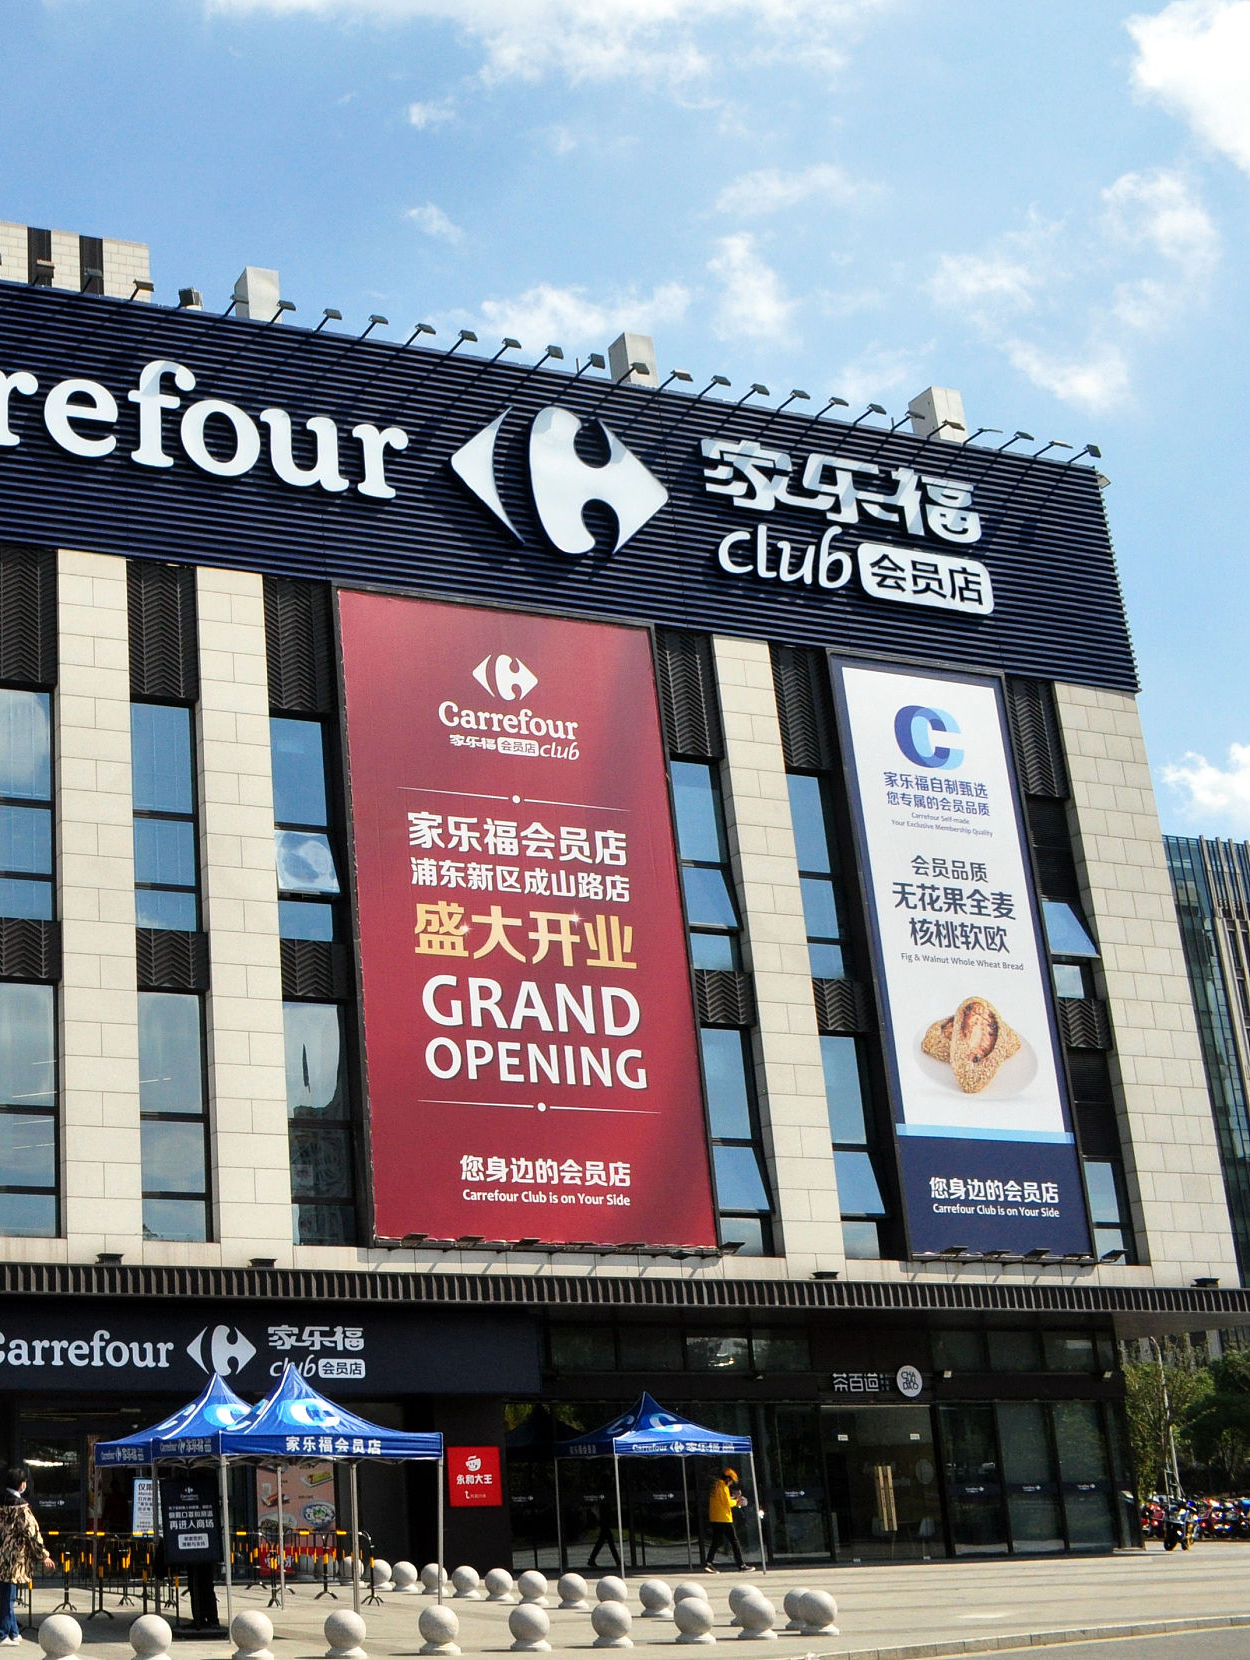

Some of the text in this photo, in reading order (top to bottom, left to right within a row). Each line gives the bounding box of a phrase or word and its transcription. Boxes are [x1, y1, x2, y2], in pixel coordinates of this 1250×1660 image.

[701, 439, 982, 543] 家乐福
[717, 523, 853, 590] club
[870, 553, 986, 606] 会员店
[439, 701, 578, 739] Carrefour
[450, 734, 536, 754] 家乐福 会员店
[540, 742, 579, 760] club
[884, 771, 988, 798] 家乐福自制甄选
[886, 791, 990, 816] 您专属的会员品质
[407, 811, 627, 866] 家乐福会员店
[907, 821, 934, 829] Exclusive
[935, 825, 971, 834] Membership
[973, 829, 993, 838] Quality
[411, 856, 630, 902] 浦东新区成山路店
[911, 855, 988, 883] 会员品质
[893, 882, 1016, 920] 无花果全麦
[414, 901, 637, 969] 盛大开业
[909, 917, 1010, 953] 核桃软欧
[901, 953, 913, 963] Fig
[922, 955, 949, 963] Walnut
[951, 958, 974, 966] Whole
[976, 960, 1001, 968] Wheat
[1003, 962, 1024, 970] Bread
[422, 974, 641, 1036] GRAND
[425, 1037, 648, 1090] OPENING
[460, 1155, 631, 1187] 您身边的会员店
[463, 1189, 630, 1205] Carrefour Club is on Your Side
[929, 1176, 1059, 1203] 您身边的会员店
[933, 1203, 1060, 1217] Carrefour Club is on Your Side
[268, 1325, 365, 1352] 家乐福
[270, 1355, 316, 1377] clb
[322, 1362, 362, 1375] 会员店
[832, 1373, 879, 1392] 茶百道
[286, 1437, 381, 1455] 家乐福会员店
